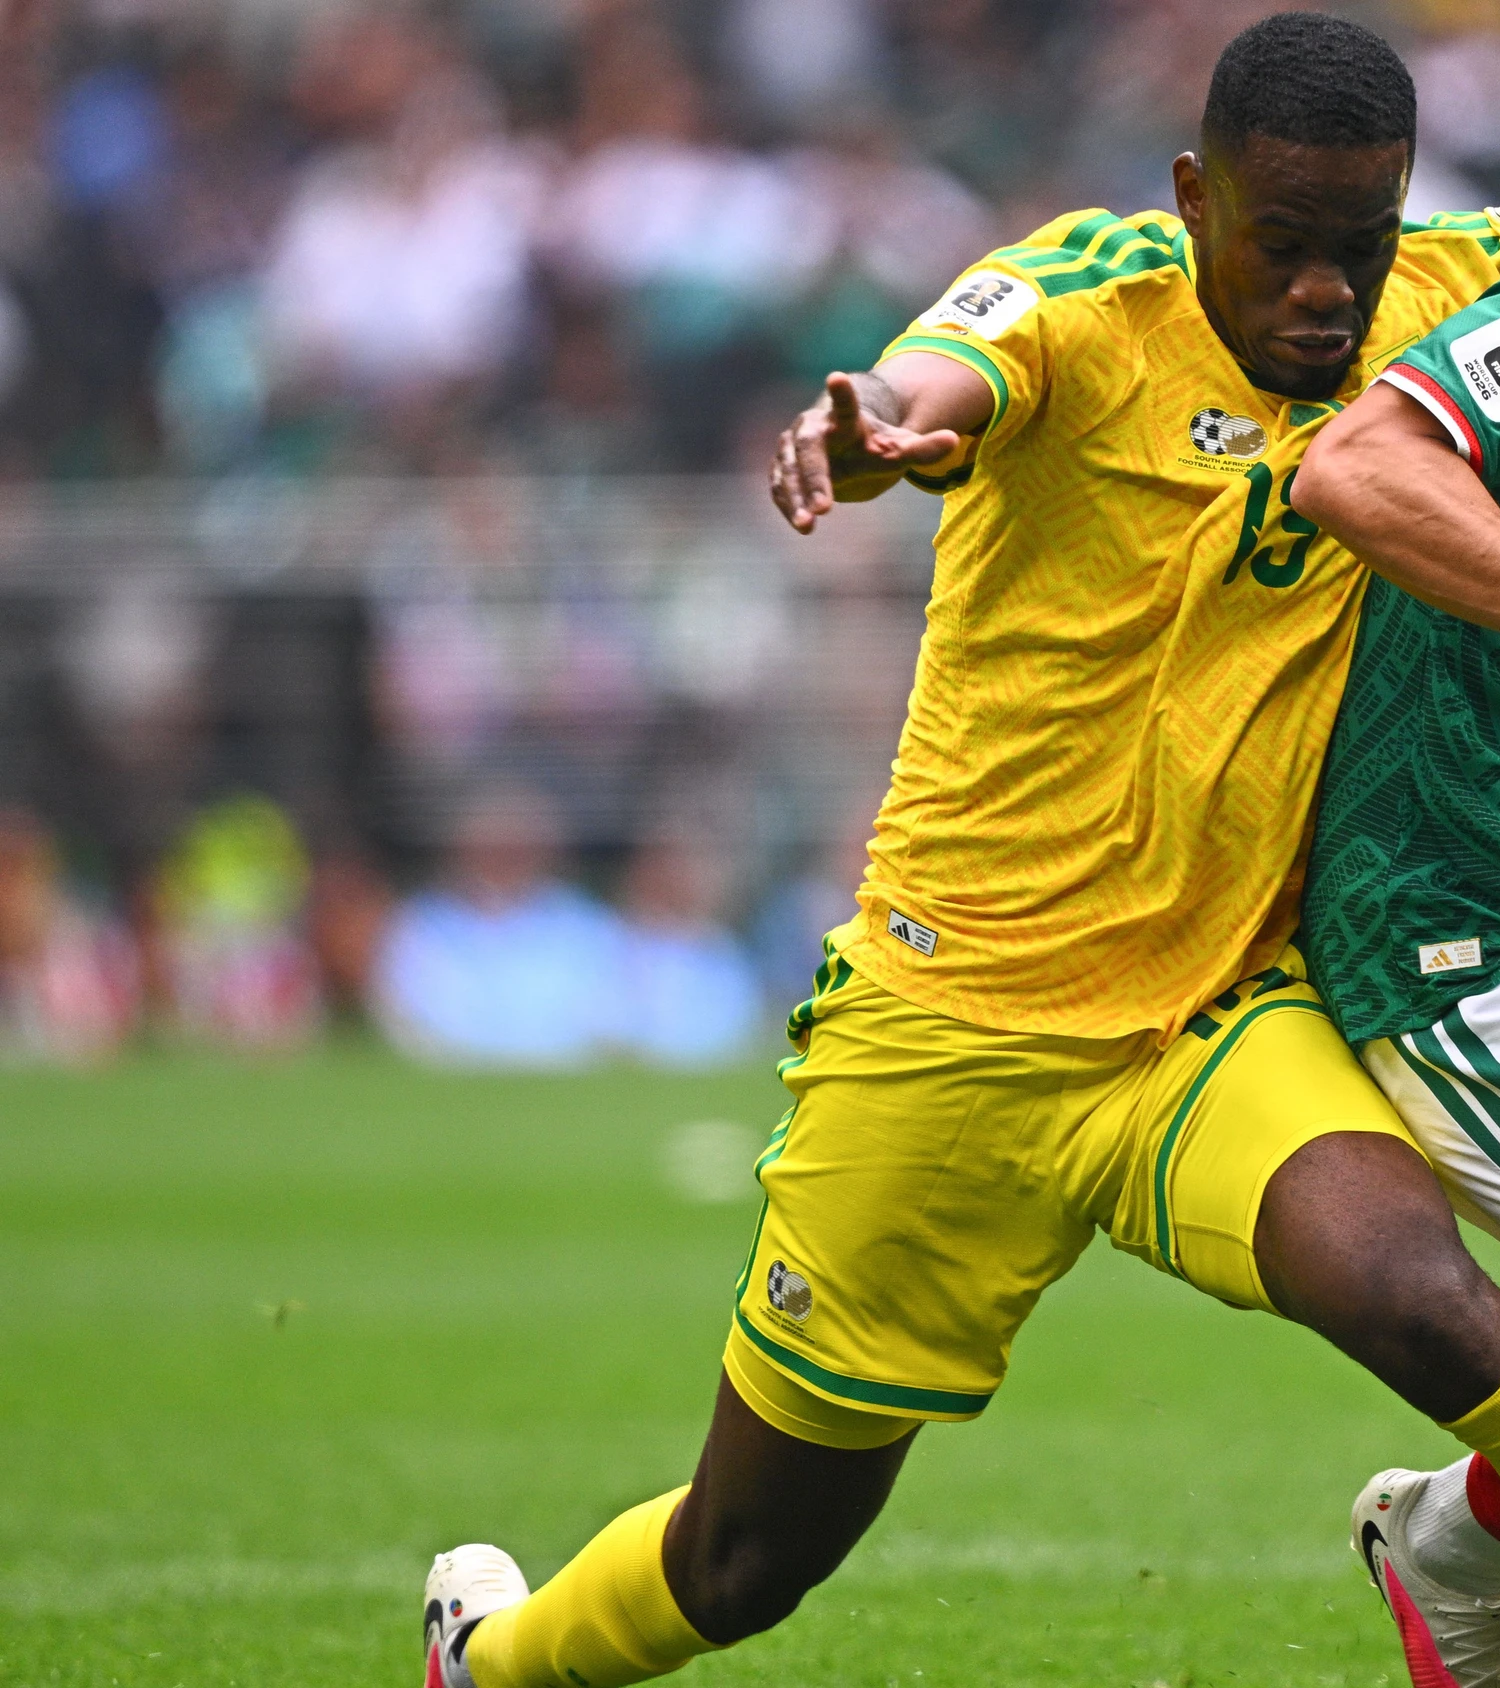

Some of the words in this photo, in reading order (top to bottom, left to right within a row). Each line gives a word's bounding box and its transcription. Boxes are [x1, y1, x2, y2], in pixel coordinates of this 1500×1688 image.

[1464, 361, 1492, 401] 2026
[1473, 358, 1490, 382] WORLD
[1487, 380, 1499, 396] CUP
[1177, 457, 1218, 470] FOOTBALL
[1194, 454, 1221, 464] SOUTH
[1222, 460, 1256, 468] AFRICAN
